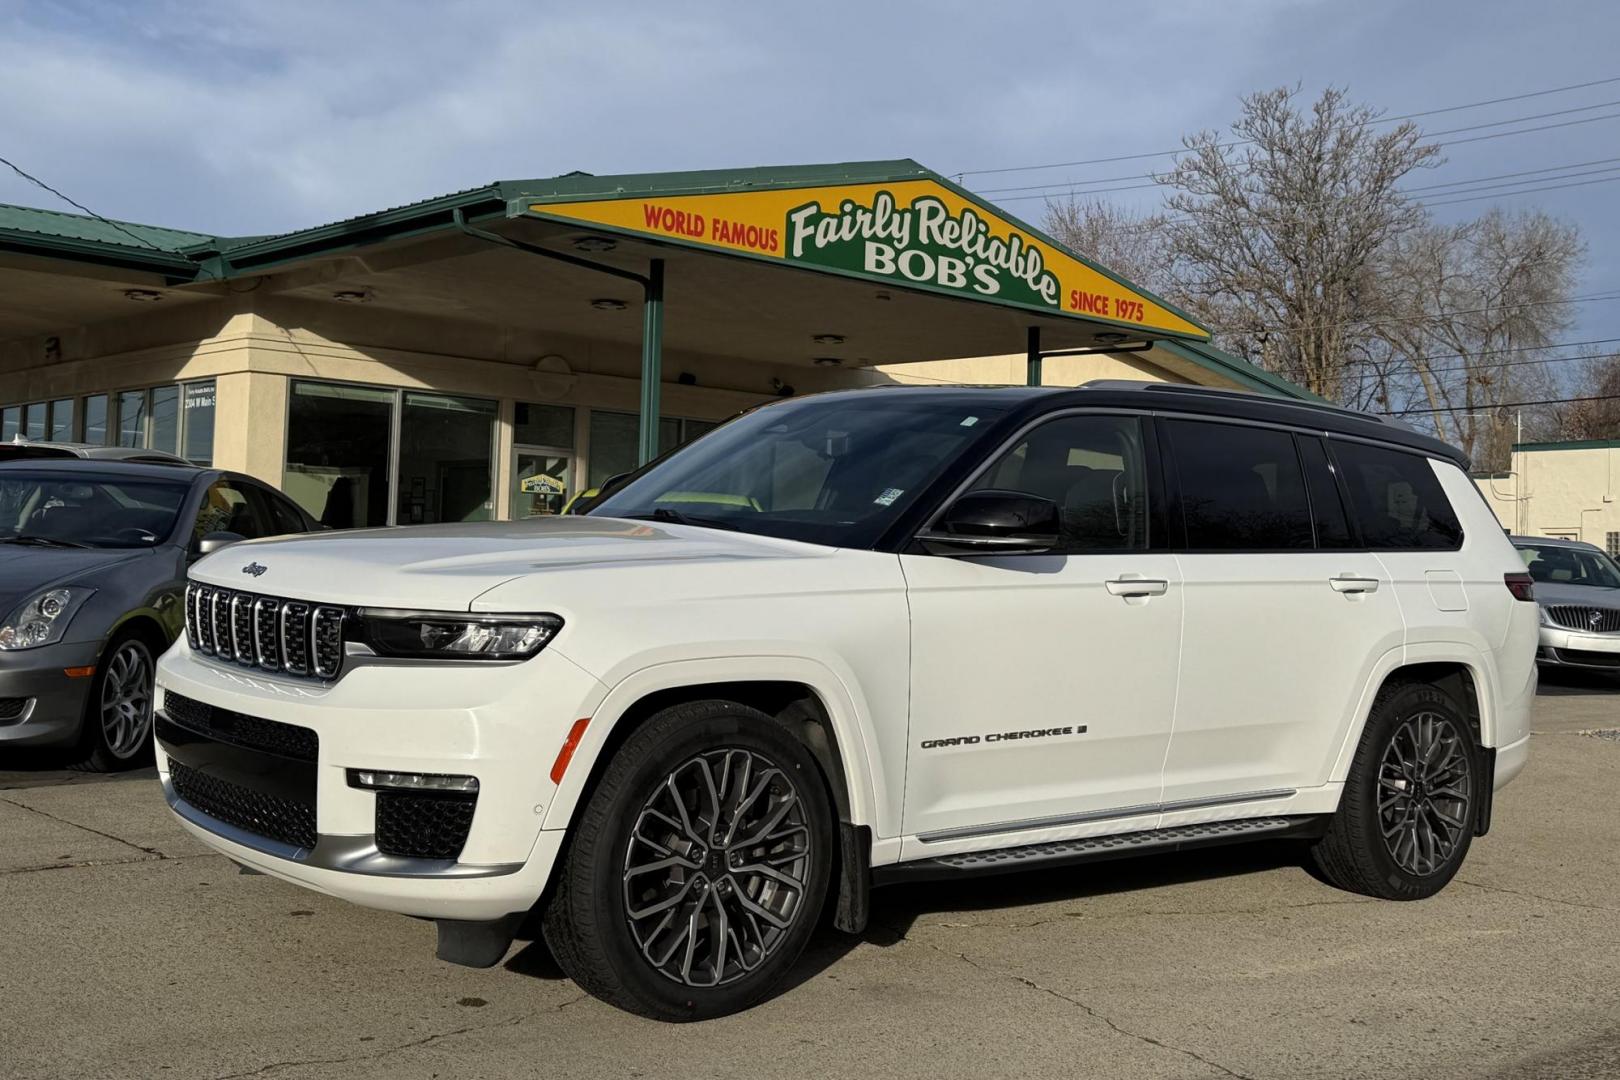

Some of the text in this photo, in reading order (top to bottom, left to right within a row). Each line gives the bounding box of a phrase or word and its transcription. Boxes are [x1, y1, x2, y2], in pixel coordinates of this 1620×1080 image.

[643, 203, 778, 252] WORLD FAMOUS
[790, 193, 1059, 305] Fairly Reliable
[864, 239, 1001, 295] BOB'S
[1070, 289, 1144, 322] SINCE 1975
[920, 735, 981, 749] GRAND
[984, 726, 1073, 742] CHEROKEE
